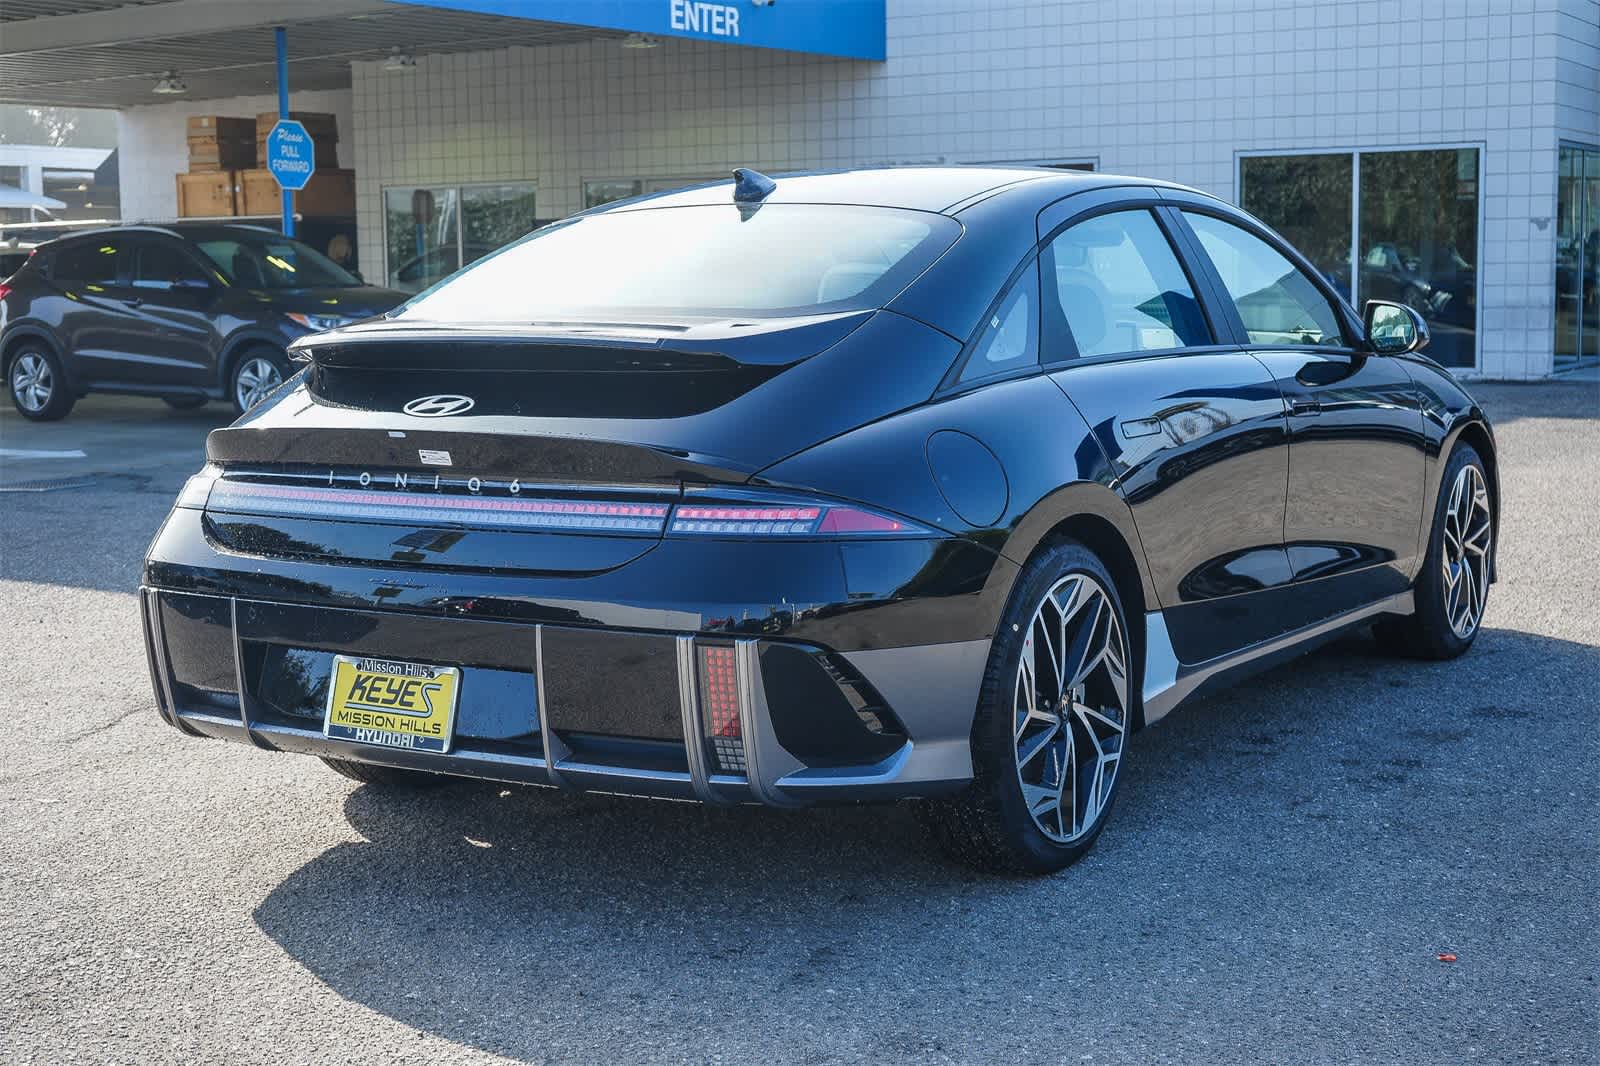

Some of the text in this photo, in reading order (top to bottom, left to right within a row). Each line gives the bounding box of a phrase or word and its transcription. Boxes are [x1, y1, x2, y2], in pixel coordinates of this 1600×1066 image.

[670, 0, 739, 37] ENTER
[276, 128, 304, 143] Please
[281, 145, 300, 158] PULL
[272, 159, 310, 173] FORWARD
[328, 470, 521, 493] IONIQ 6
[364, 659, 429, 678] Mission Hills
[345, 674, 443, 718] KEYES
[337, 710, 441, 735] MISSION HILLS
